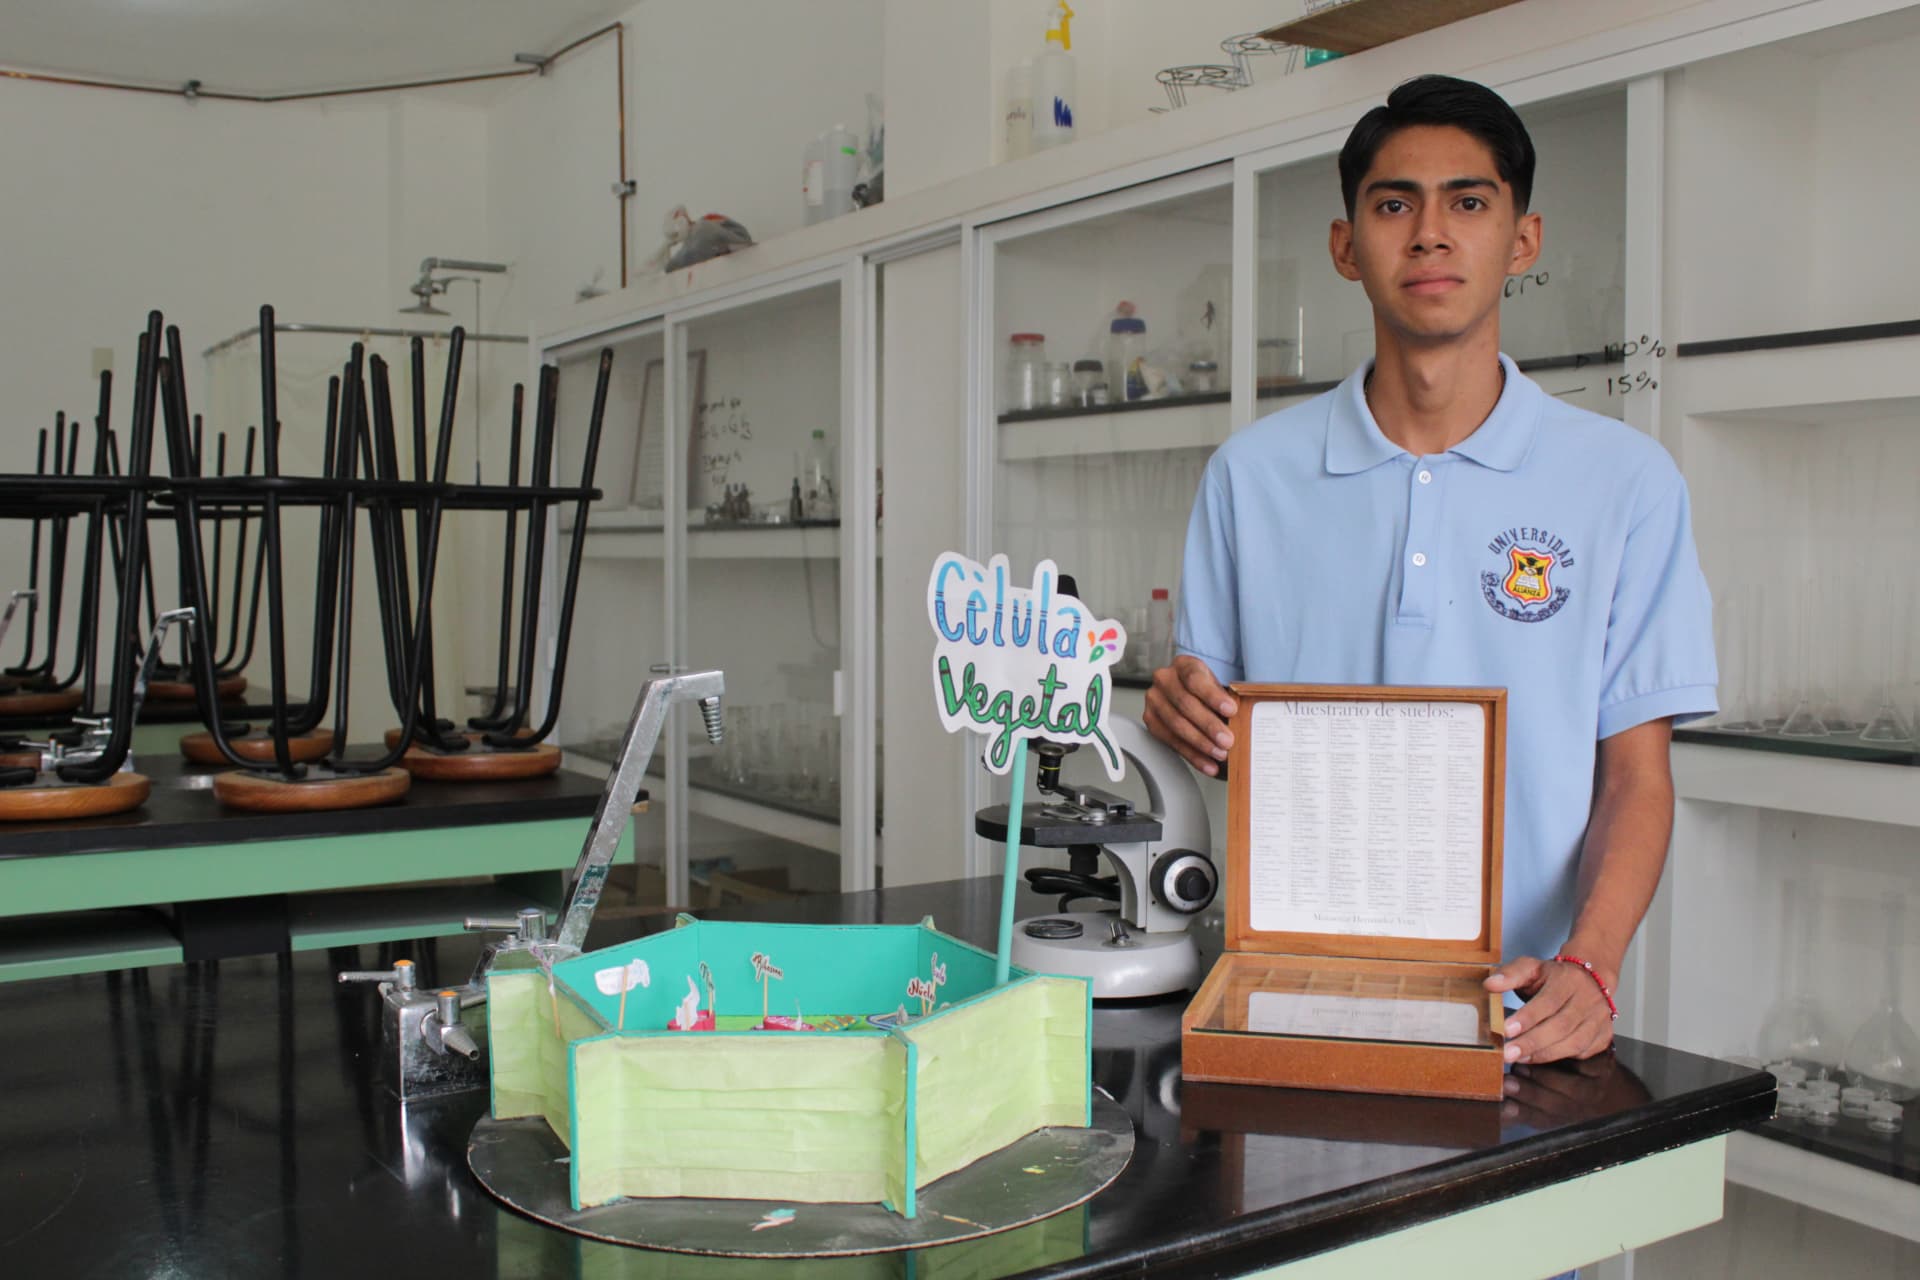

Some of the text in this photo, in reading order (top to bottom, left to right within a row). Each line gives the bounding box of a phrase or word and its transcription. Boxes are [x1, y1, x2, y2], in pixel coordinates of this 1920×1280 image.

[1607, 371, 1658, 396] 15%
[1487, 527, 1575, 568] UNIVERSIDAD
[938, 656, 1119, 769] Vegetal
[1283, 701, 1455, 719] Muestrario de suelos:
